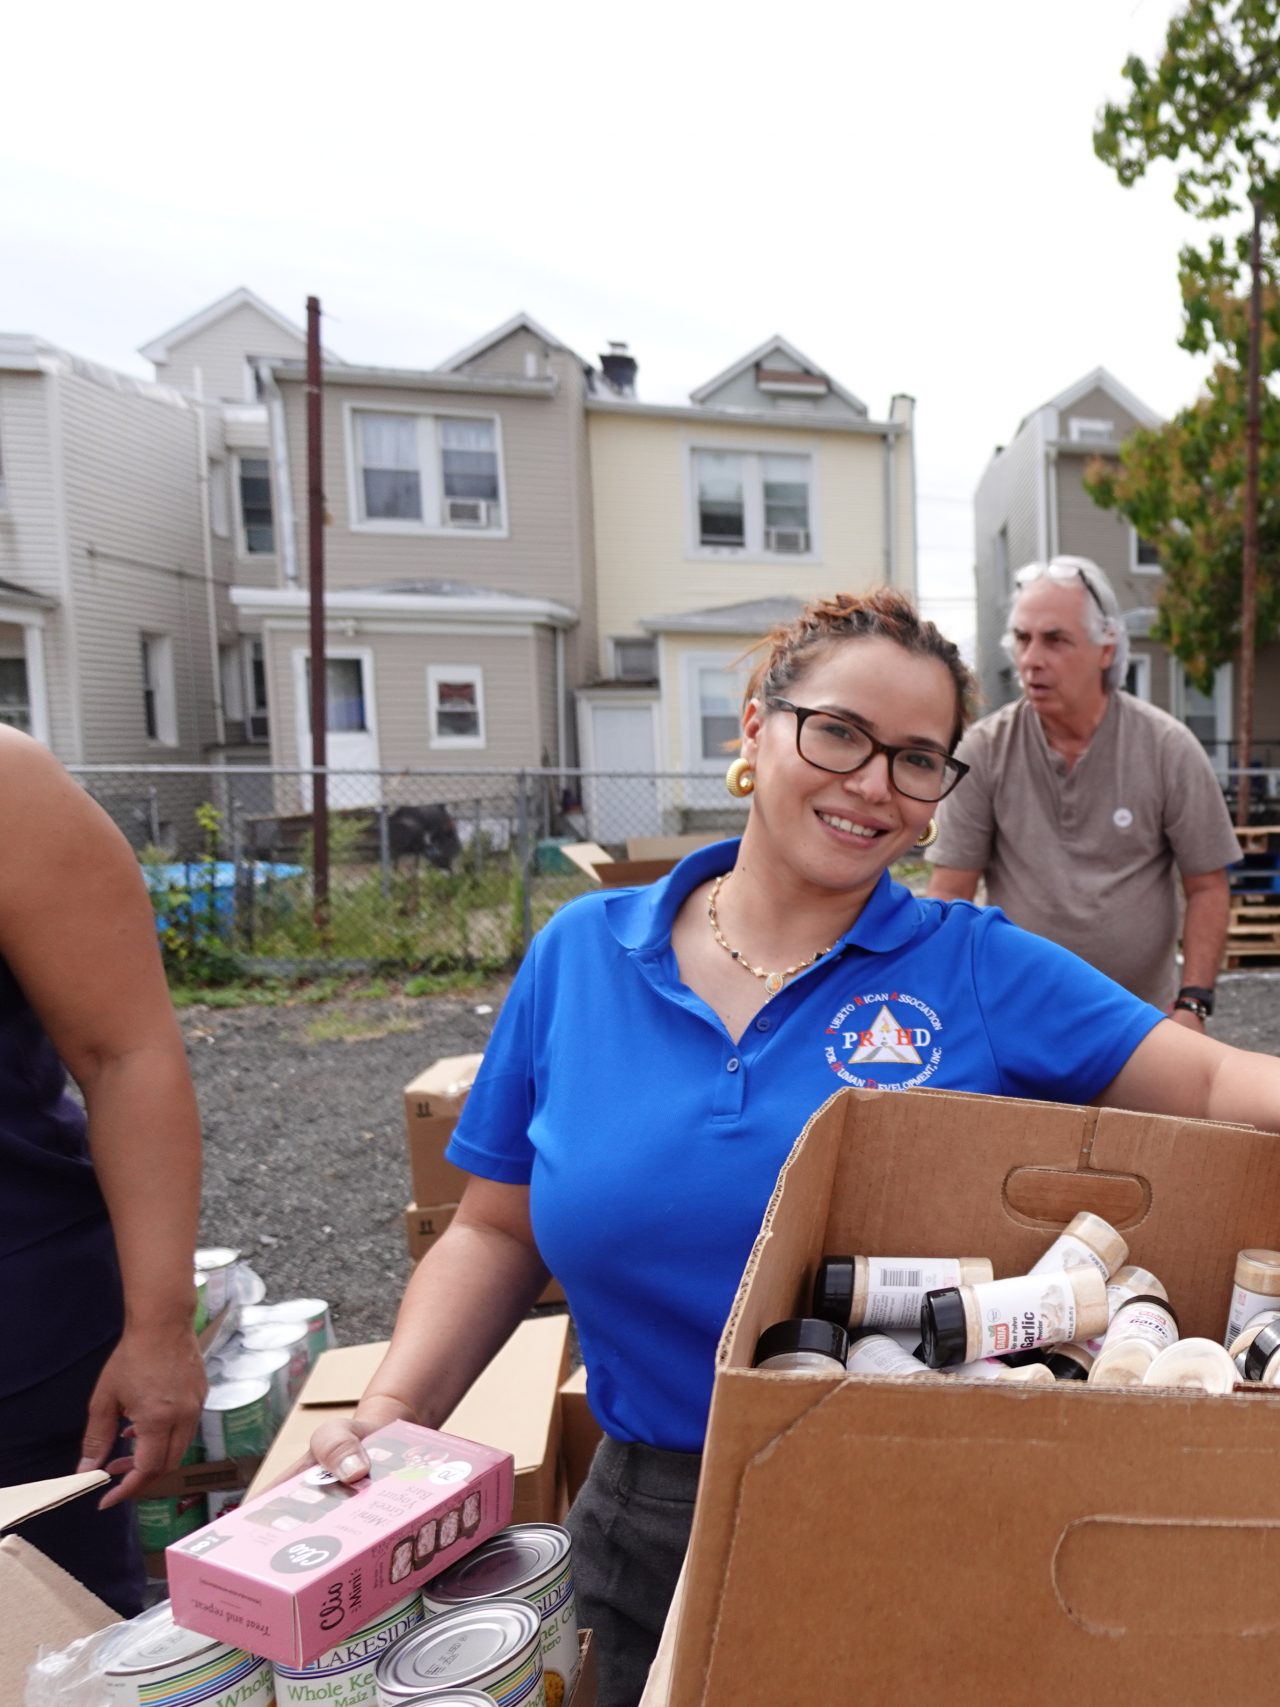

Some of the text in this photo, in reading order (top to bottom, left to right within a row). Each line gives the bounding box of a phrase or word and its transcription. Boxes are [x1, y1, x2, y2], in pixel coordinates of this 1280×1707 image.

[825, 991, 943, 1035] PUERTO RICAN ASSOCIATION
[824, 1046, 837, 1064] FOR
[831, 1061, 866, 1087] HUMAN
[1020, 1312, 1035, 1349] Garlic
[288, 1543, 330, 1566] Clio
[226, 1612, 244, 1624] and
[320, 1582, 345, 1631] Clio
[245, 1619, 271, 1637] Treat
[216, 1668, 272, 1707] Whole
[288, 1681, 343, 1701] Whole
